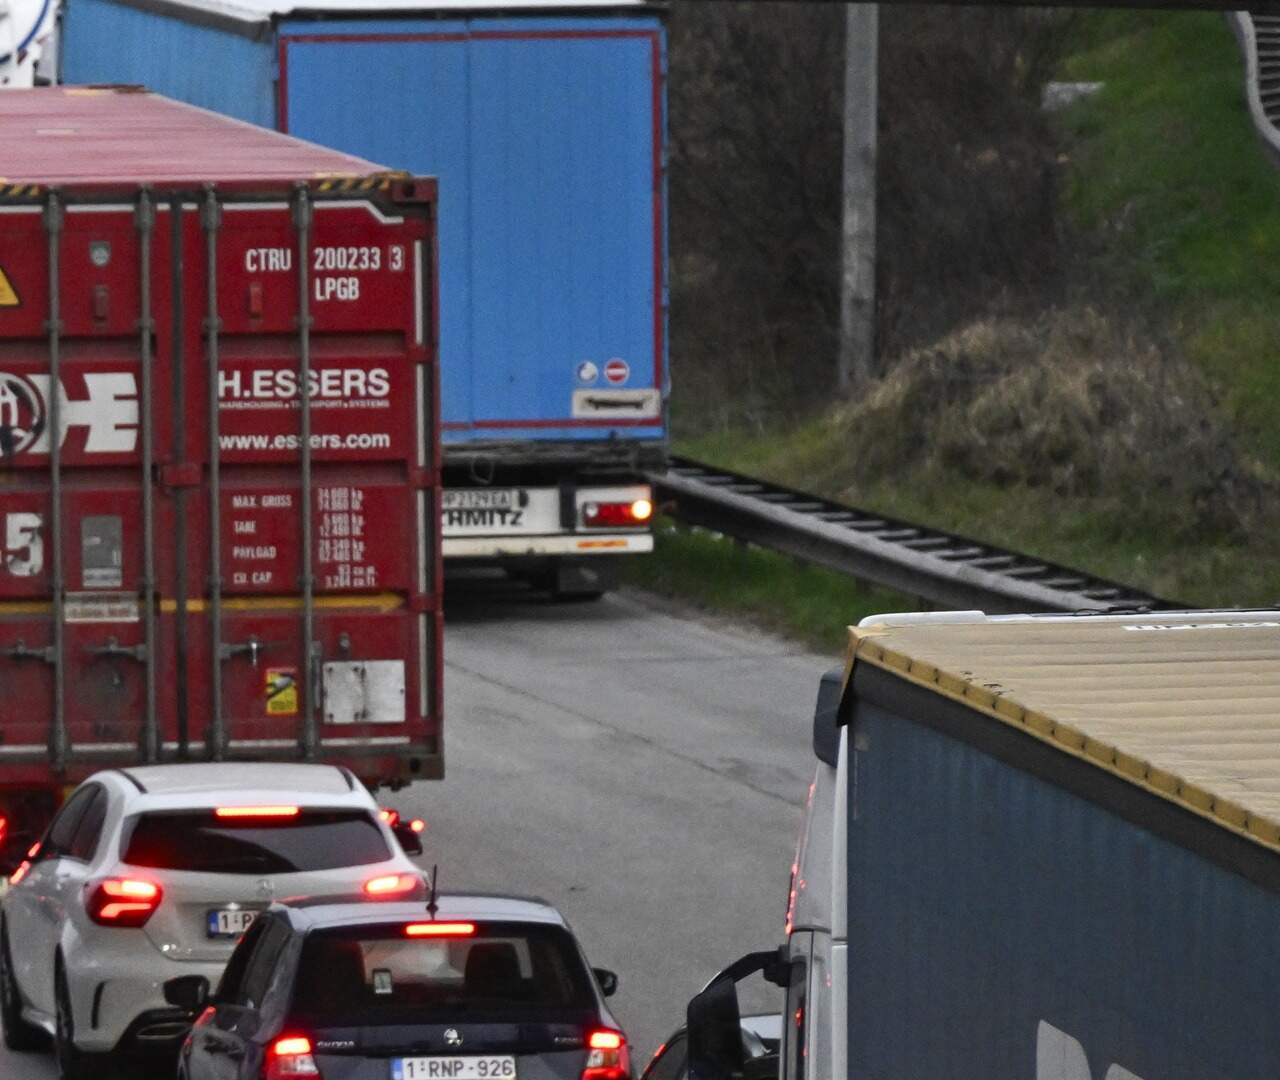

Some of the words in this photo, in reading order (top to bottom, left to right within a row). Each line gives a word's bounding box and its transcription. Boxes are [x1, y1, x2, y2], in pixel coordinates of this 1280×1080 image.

[246, 248, 291, 271] CTRU
[314, 247, 381, 270] 200233
[391, 247, 402, 270] 3
[315, 277, 359, 300] LPGB
[218, 368, 390, 398] H.ESSERS
[219, 433, 390, 449] www.esers.com
[233, 546, 277, 559] PAYLOAD
[406, 1060, 513, 1079] 1-RNP-926
